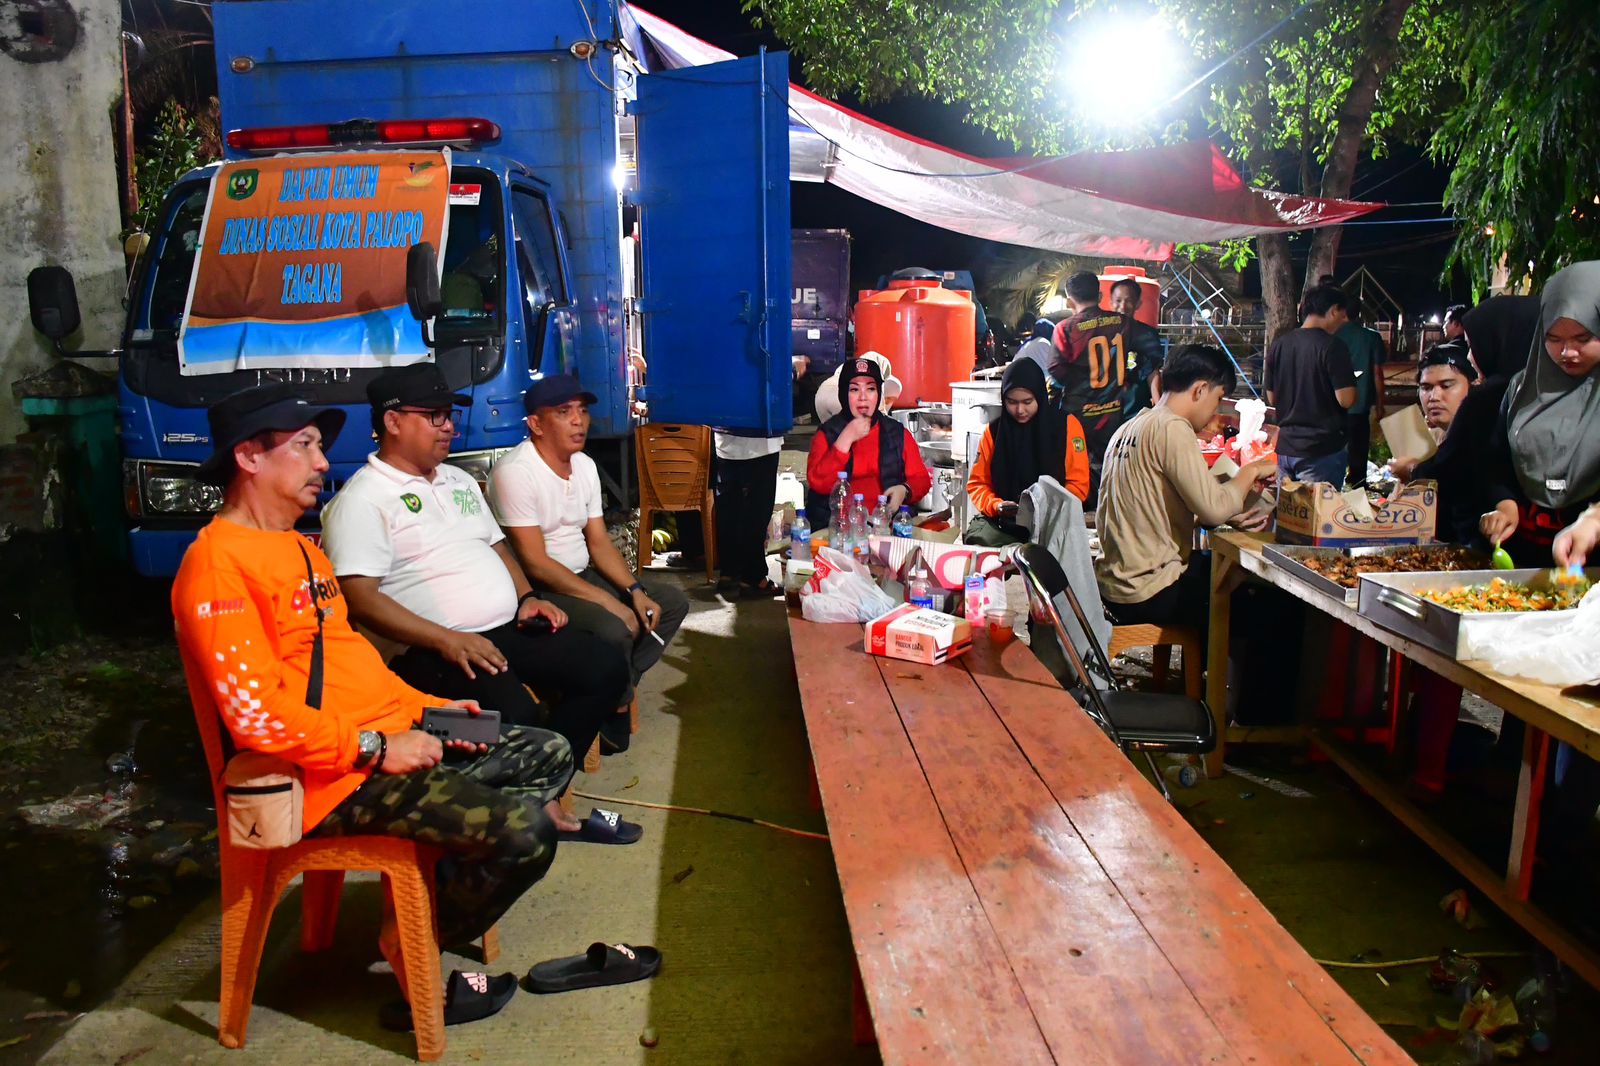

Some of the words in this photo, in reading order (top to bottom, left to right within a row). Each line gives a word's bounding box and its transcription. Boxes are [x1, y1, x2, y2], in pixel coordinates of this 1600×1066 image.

[279, 167, 332, 202] DAPUR
[332, 164, 379, 199] UMUM
[219, 216, 268, 255] DINAS
[266, 213, 320, 252] SOSIAL
[320, 211, 361, 249] KOTA
[363, 210, 423, 248] PALOPO
[281, 262, 342, 304] TAGANA
[1088, 332, 1125, 389] 01
